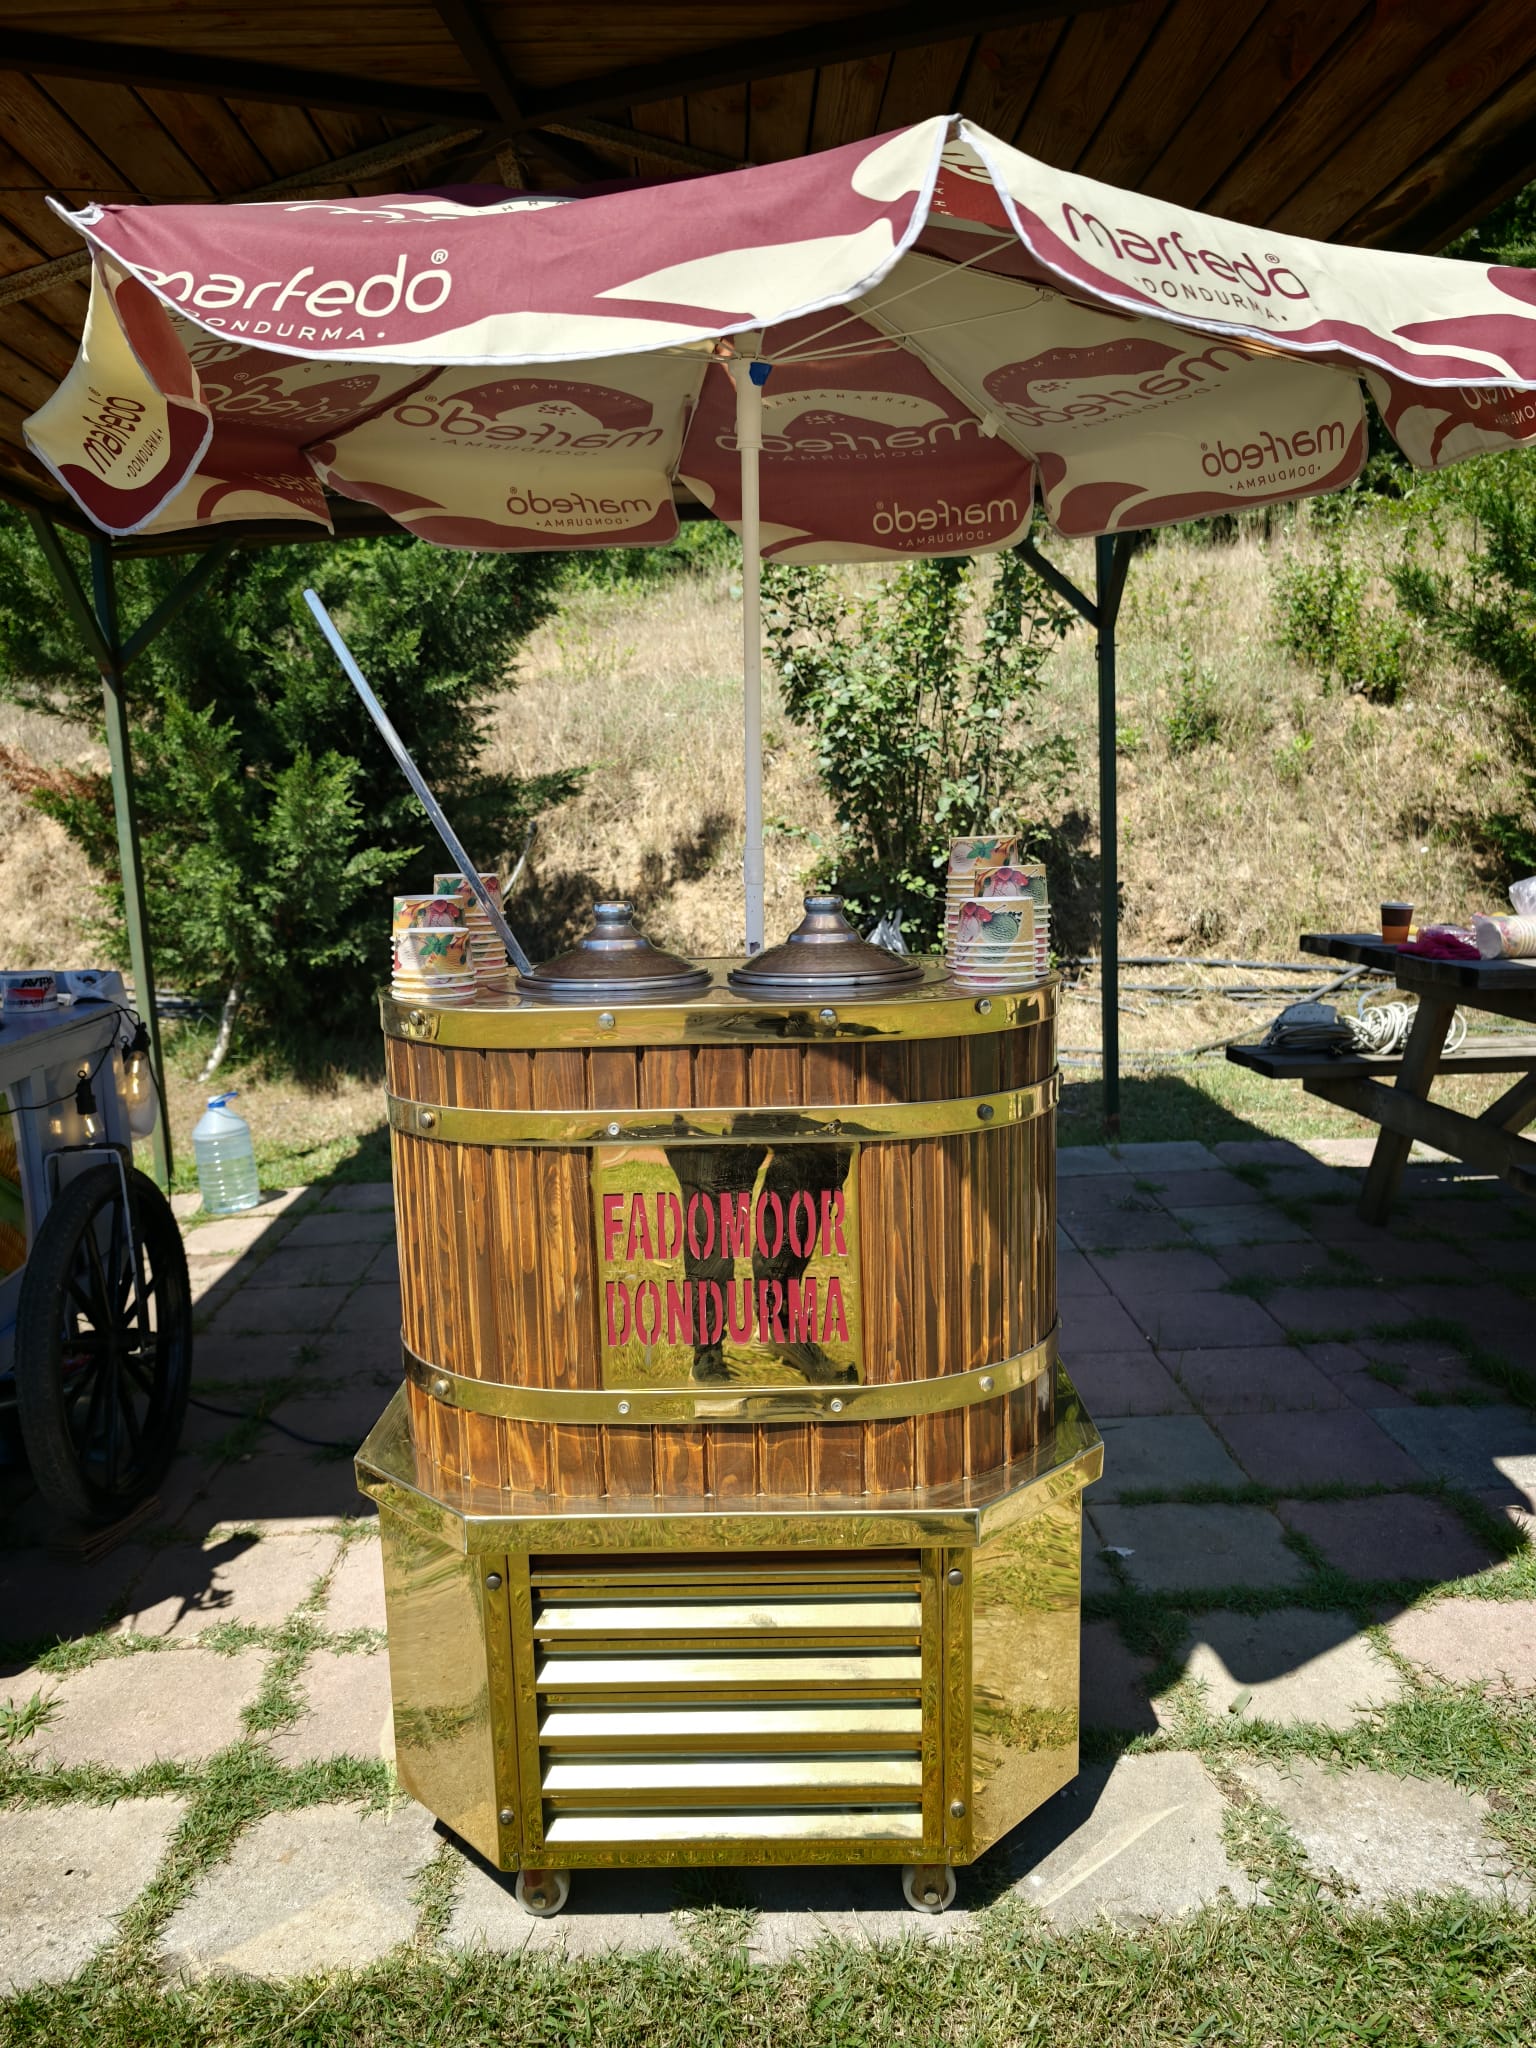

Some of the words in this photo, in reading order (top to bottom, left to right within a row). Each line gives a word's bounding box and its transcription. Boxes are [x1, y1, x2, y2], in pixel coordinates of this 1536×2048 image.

[1062, 202, 1310, 299] marfedo
[1142, 277, 1280, 320] DONDURMA
[127, 429, 164, 478] DONDURMA
[603, 1189, 849, 1262] FADOMOOR
[606, 1277, 850, 1346] DONDURMA
